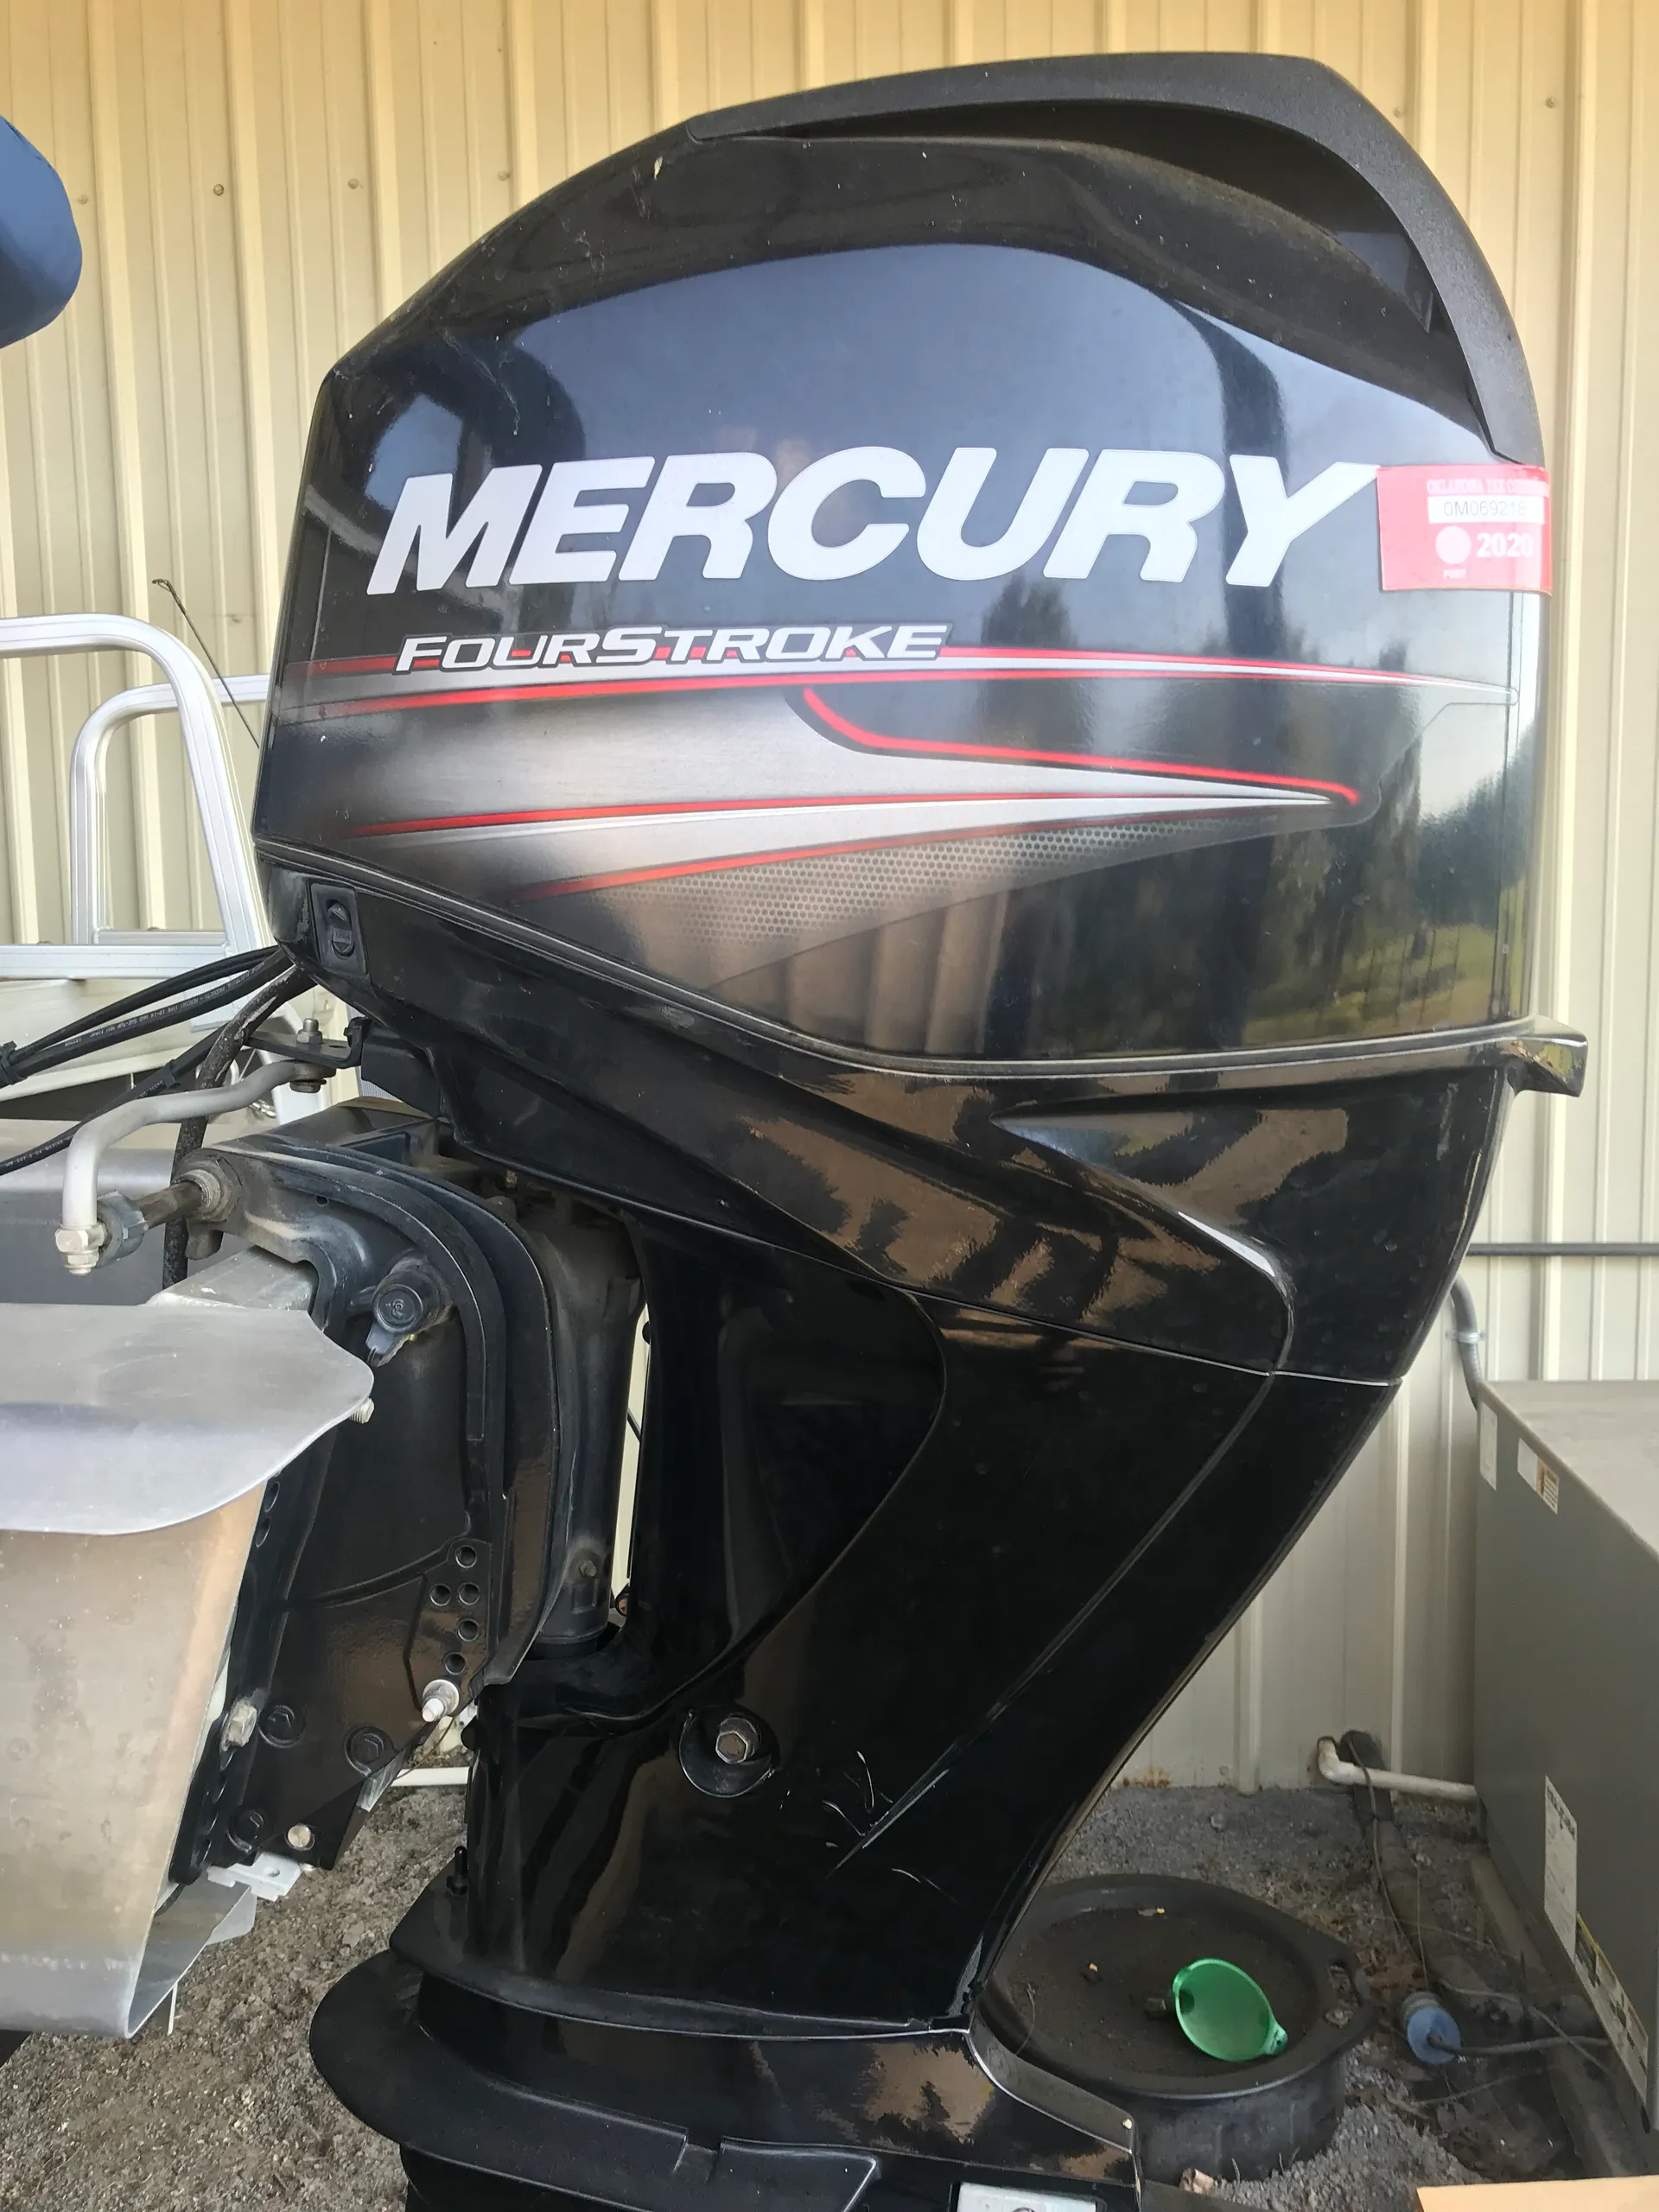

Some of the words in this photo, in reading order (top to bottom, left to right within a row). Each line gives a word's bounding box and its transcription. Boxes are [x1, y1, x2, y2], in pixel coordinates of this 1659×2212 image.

[366, 446, 1381, 595] MERCURY
[1476, 532, 1534, 557] 2020
[395, 625, 949, 673] FOURSTROKE
